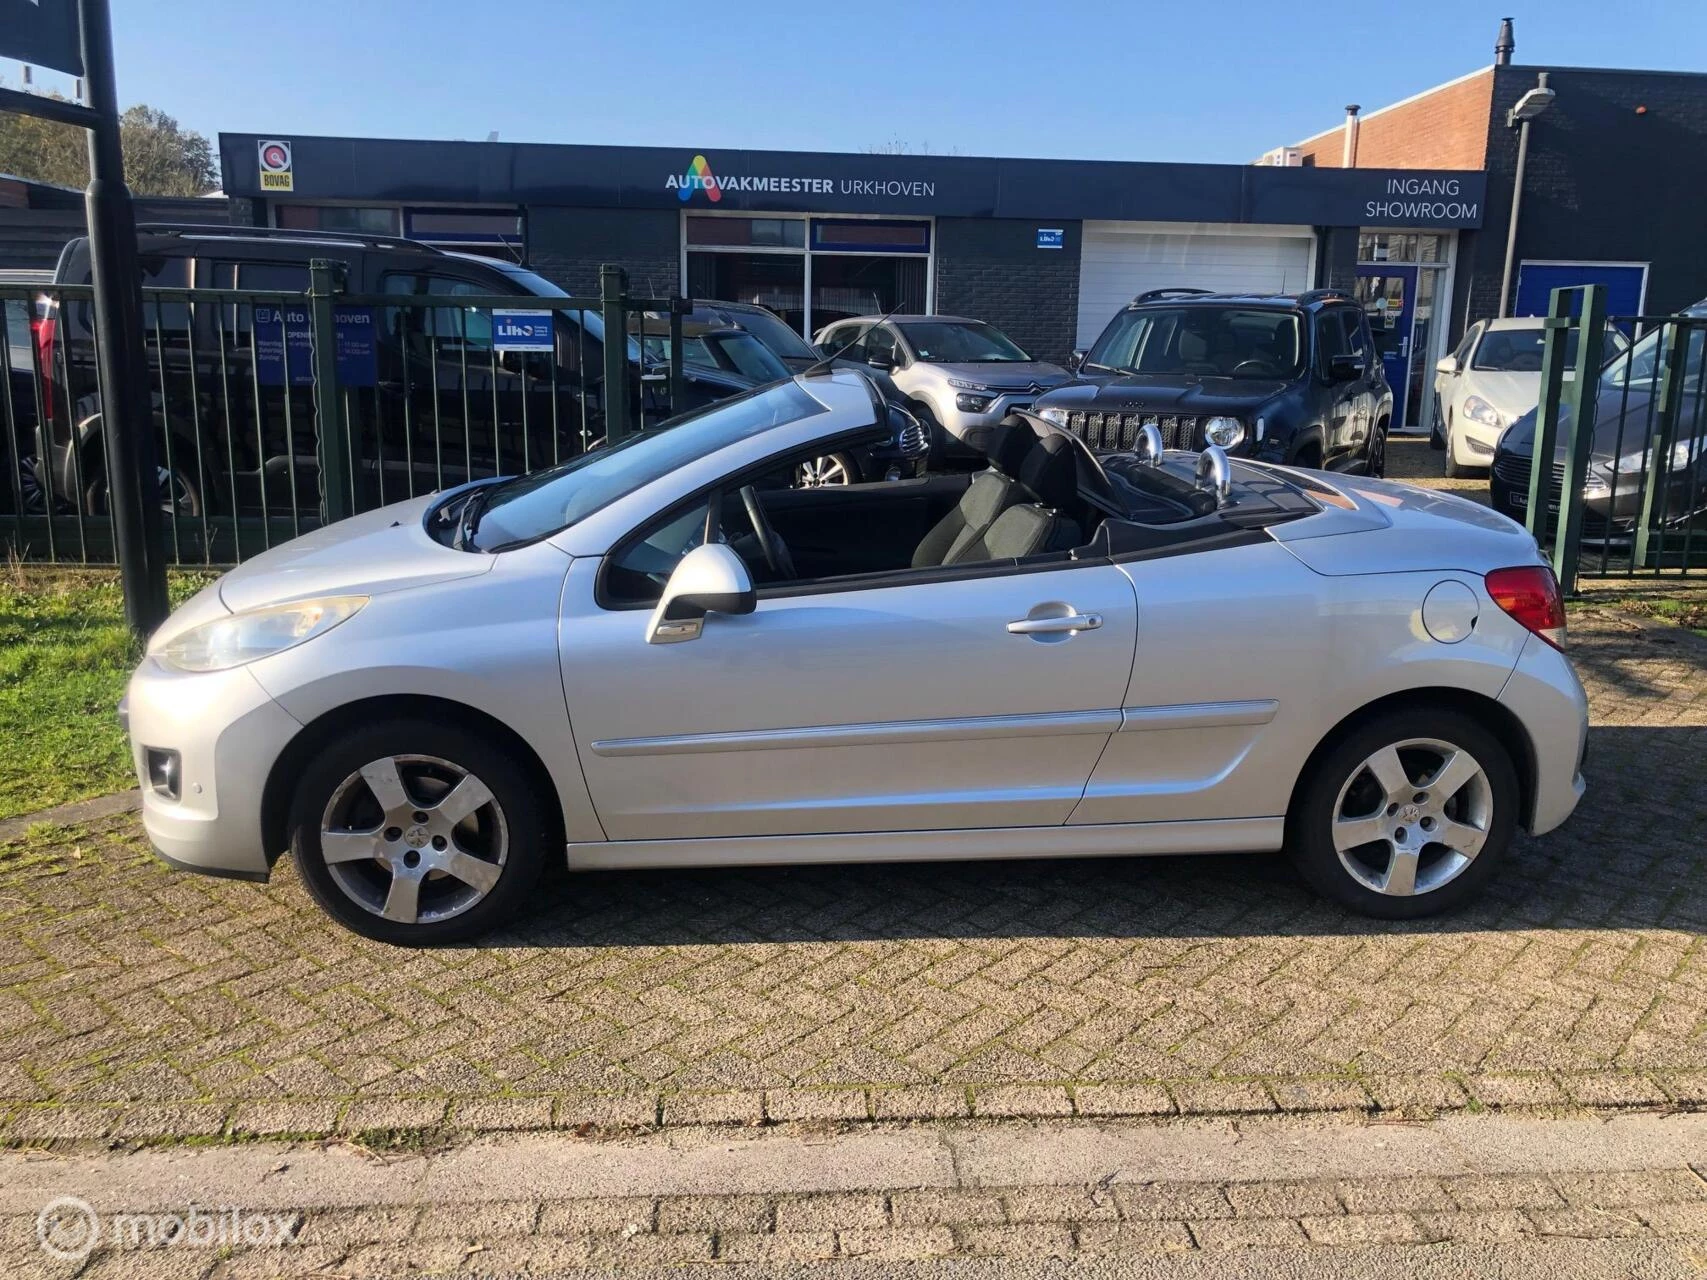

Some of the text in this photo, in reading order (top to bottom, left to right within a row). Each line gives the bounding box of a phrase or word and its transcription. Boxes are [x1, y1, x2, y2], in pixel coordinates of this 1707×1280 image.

[264, 174, 290, 188] BOVAG
[665, 174, 936, 197] AUTOVAKMEESTER URKHOVEN
[1386, 178, 1461, 196] INGANG
[1365, 201, 1478, 219] SHOWROOM
